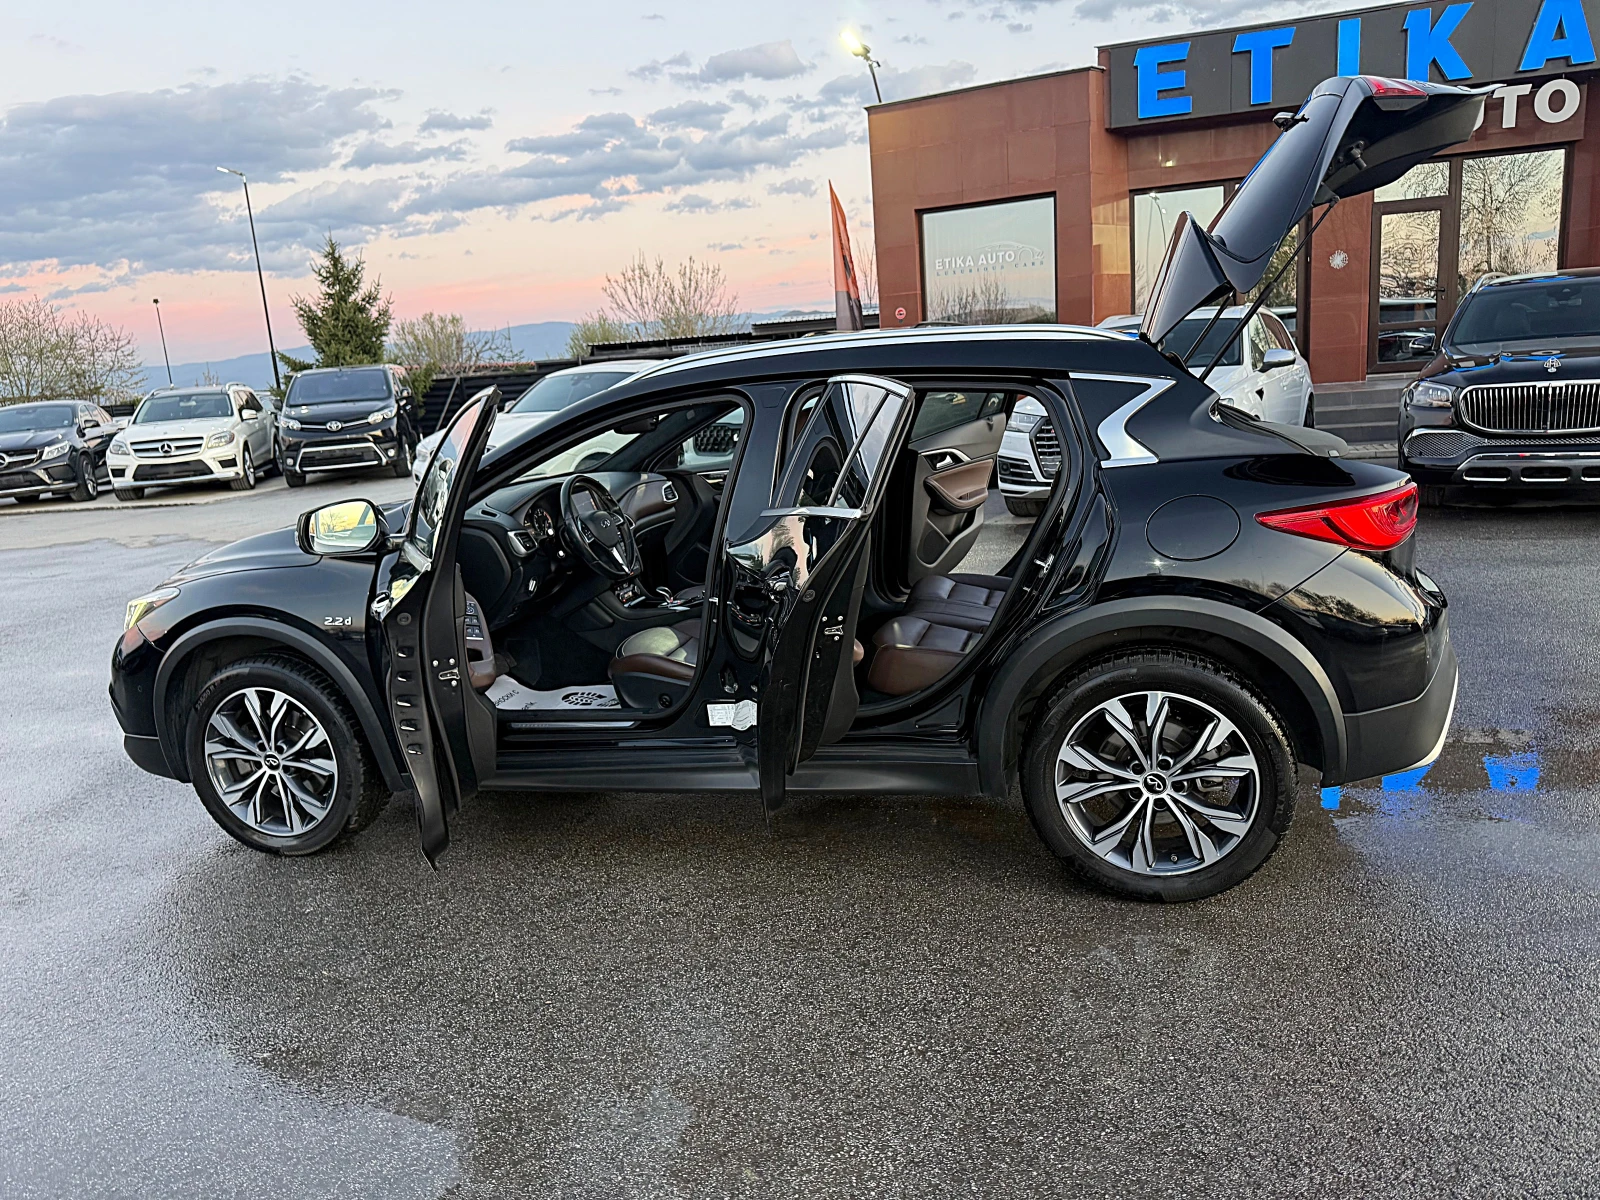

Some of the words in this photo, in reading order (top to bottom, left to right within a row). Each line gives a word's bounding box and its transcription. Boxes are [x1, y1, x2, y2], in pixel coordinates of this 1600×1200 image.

[1133, 0, 1596, 119] ETIKA
[1473, 79, 1580, 131] TO
[935, 255, 974, 270] ETIKA
[978, 251, 1015, 265] AUTO
